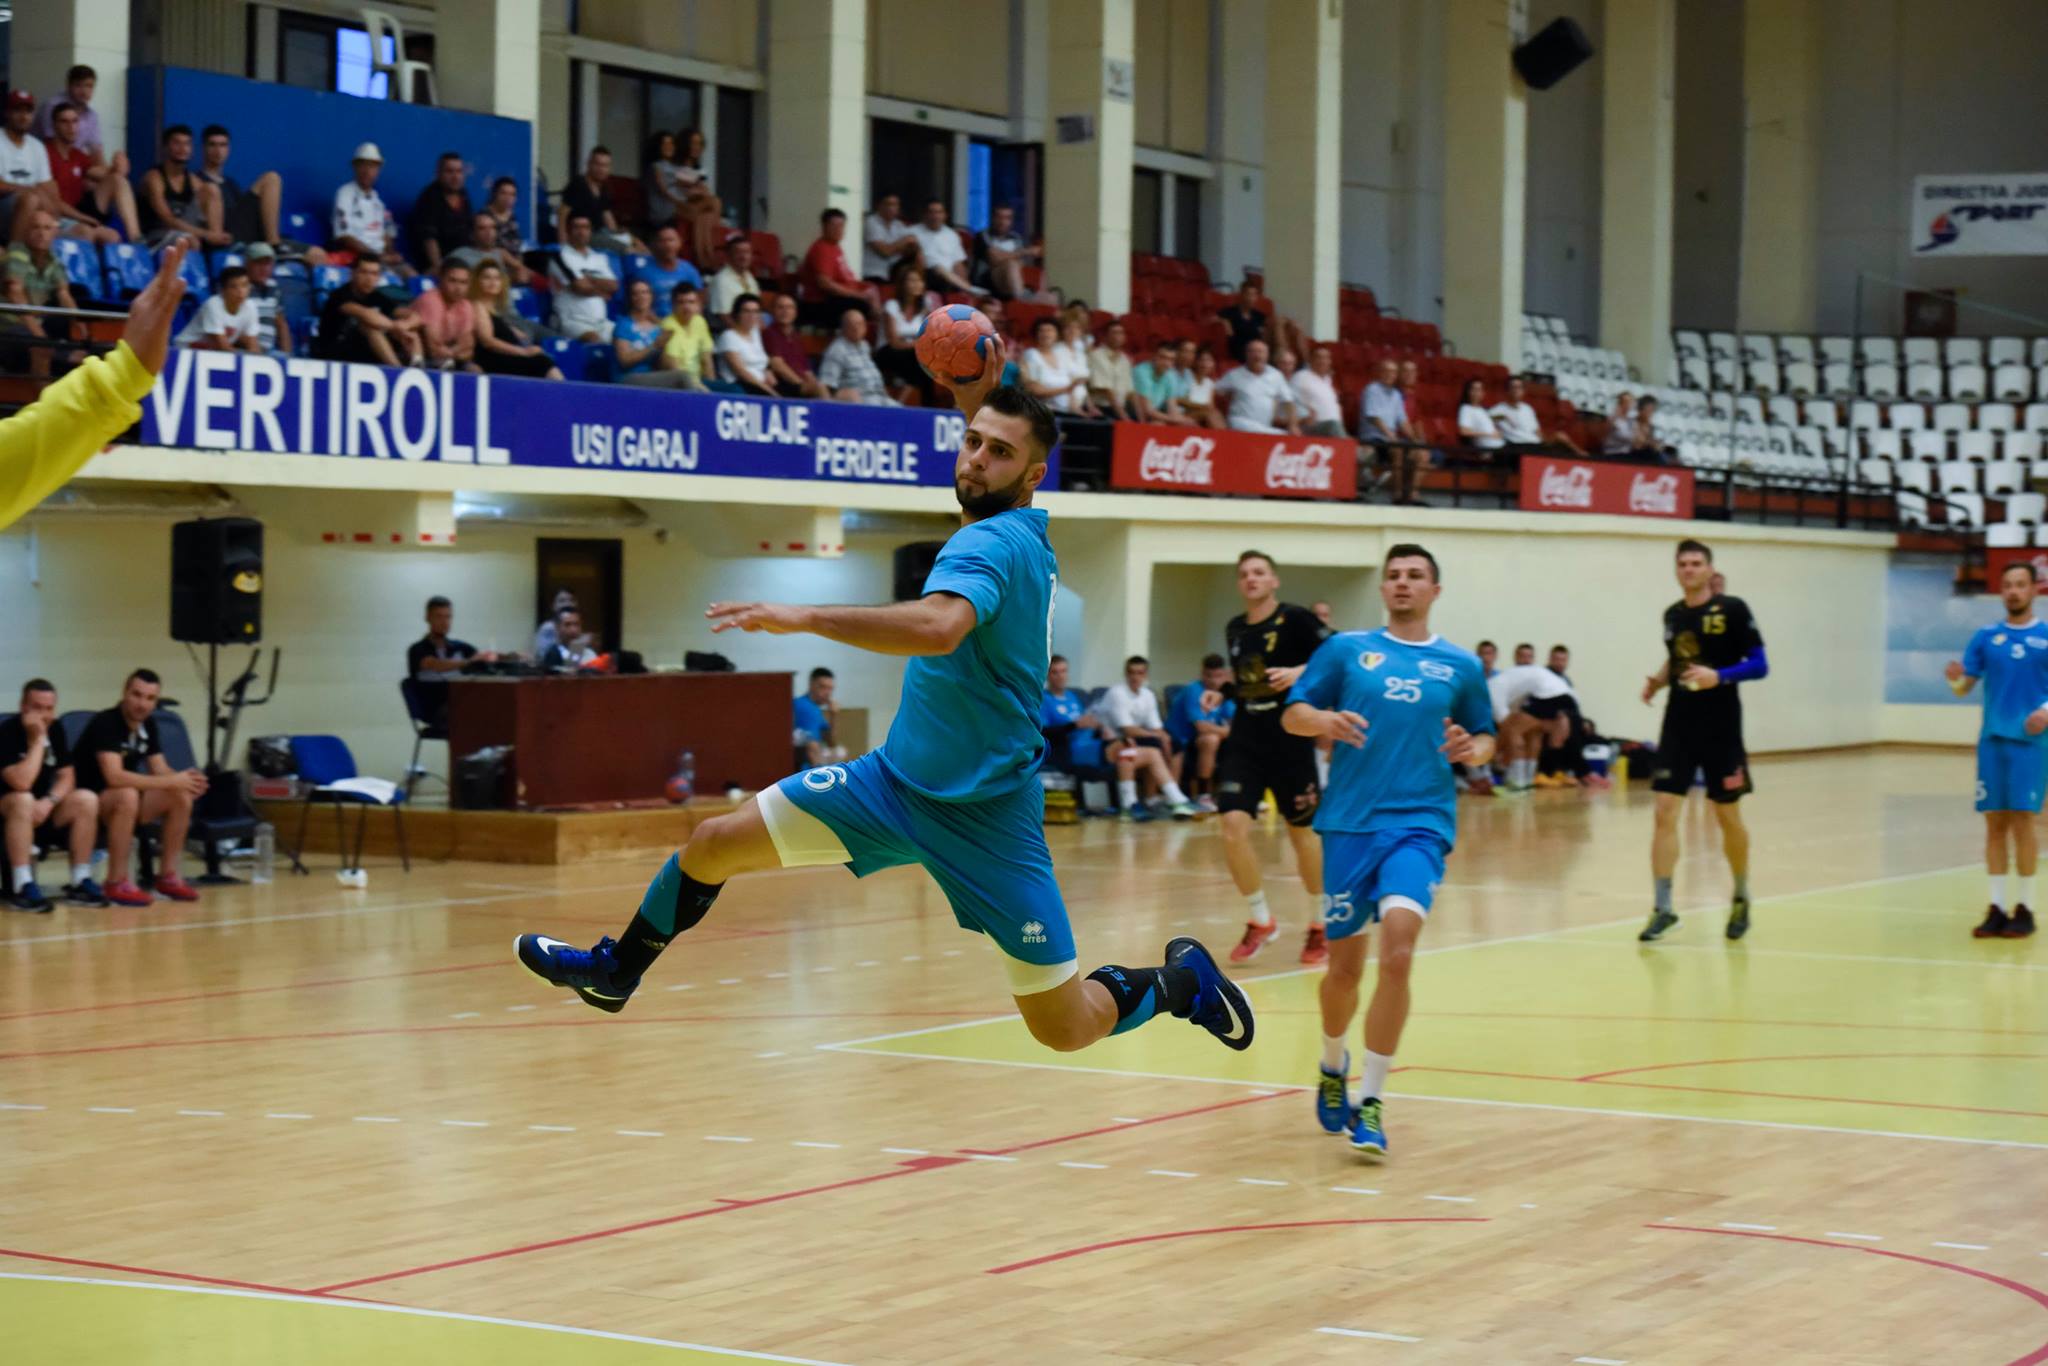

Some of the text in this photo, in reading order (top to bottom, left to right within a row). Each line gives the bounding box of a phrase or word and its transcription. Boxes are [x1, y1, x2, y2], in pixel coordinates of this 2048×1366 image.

[152, 348, 510, 464] VERTIROLL
[715, 399, 810, 445] GRILAJE
[571, 423, 699, 470] USI GARAJ
[815, 436, 919, 481] PERDELE
[1263, 631, 1279, 652] 7
[1701, 614, 1727, 635] 15
[1383, 676, 1422, 704] 25
[802, 765, 848, 793] 6
